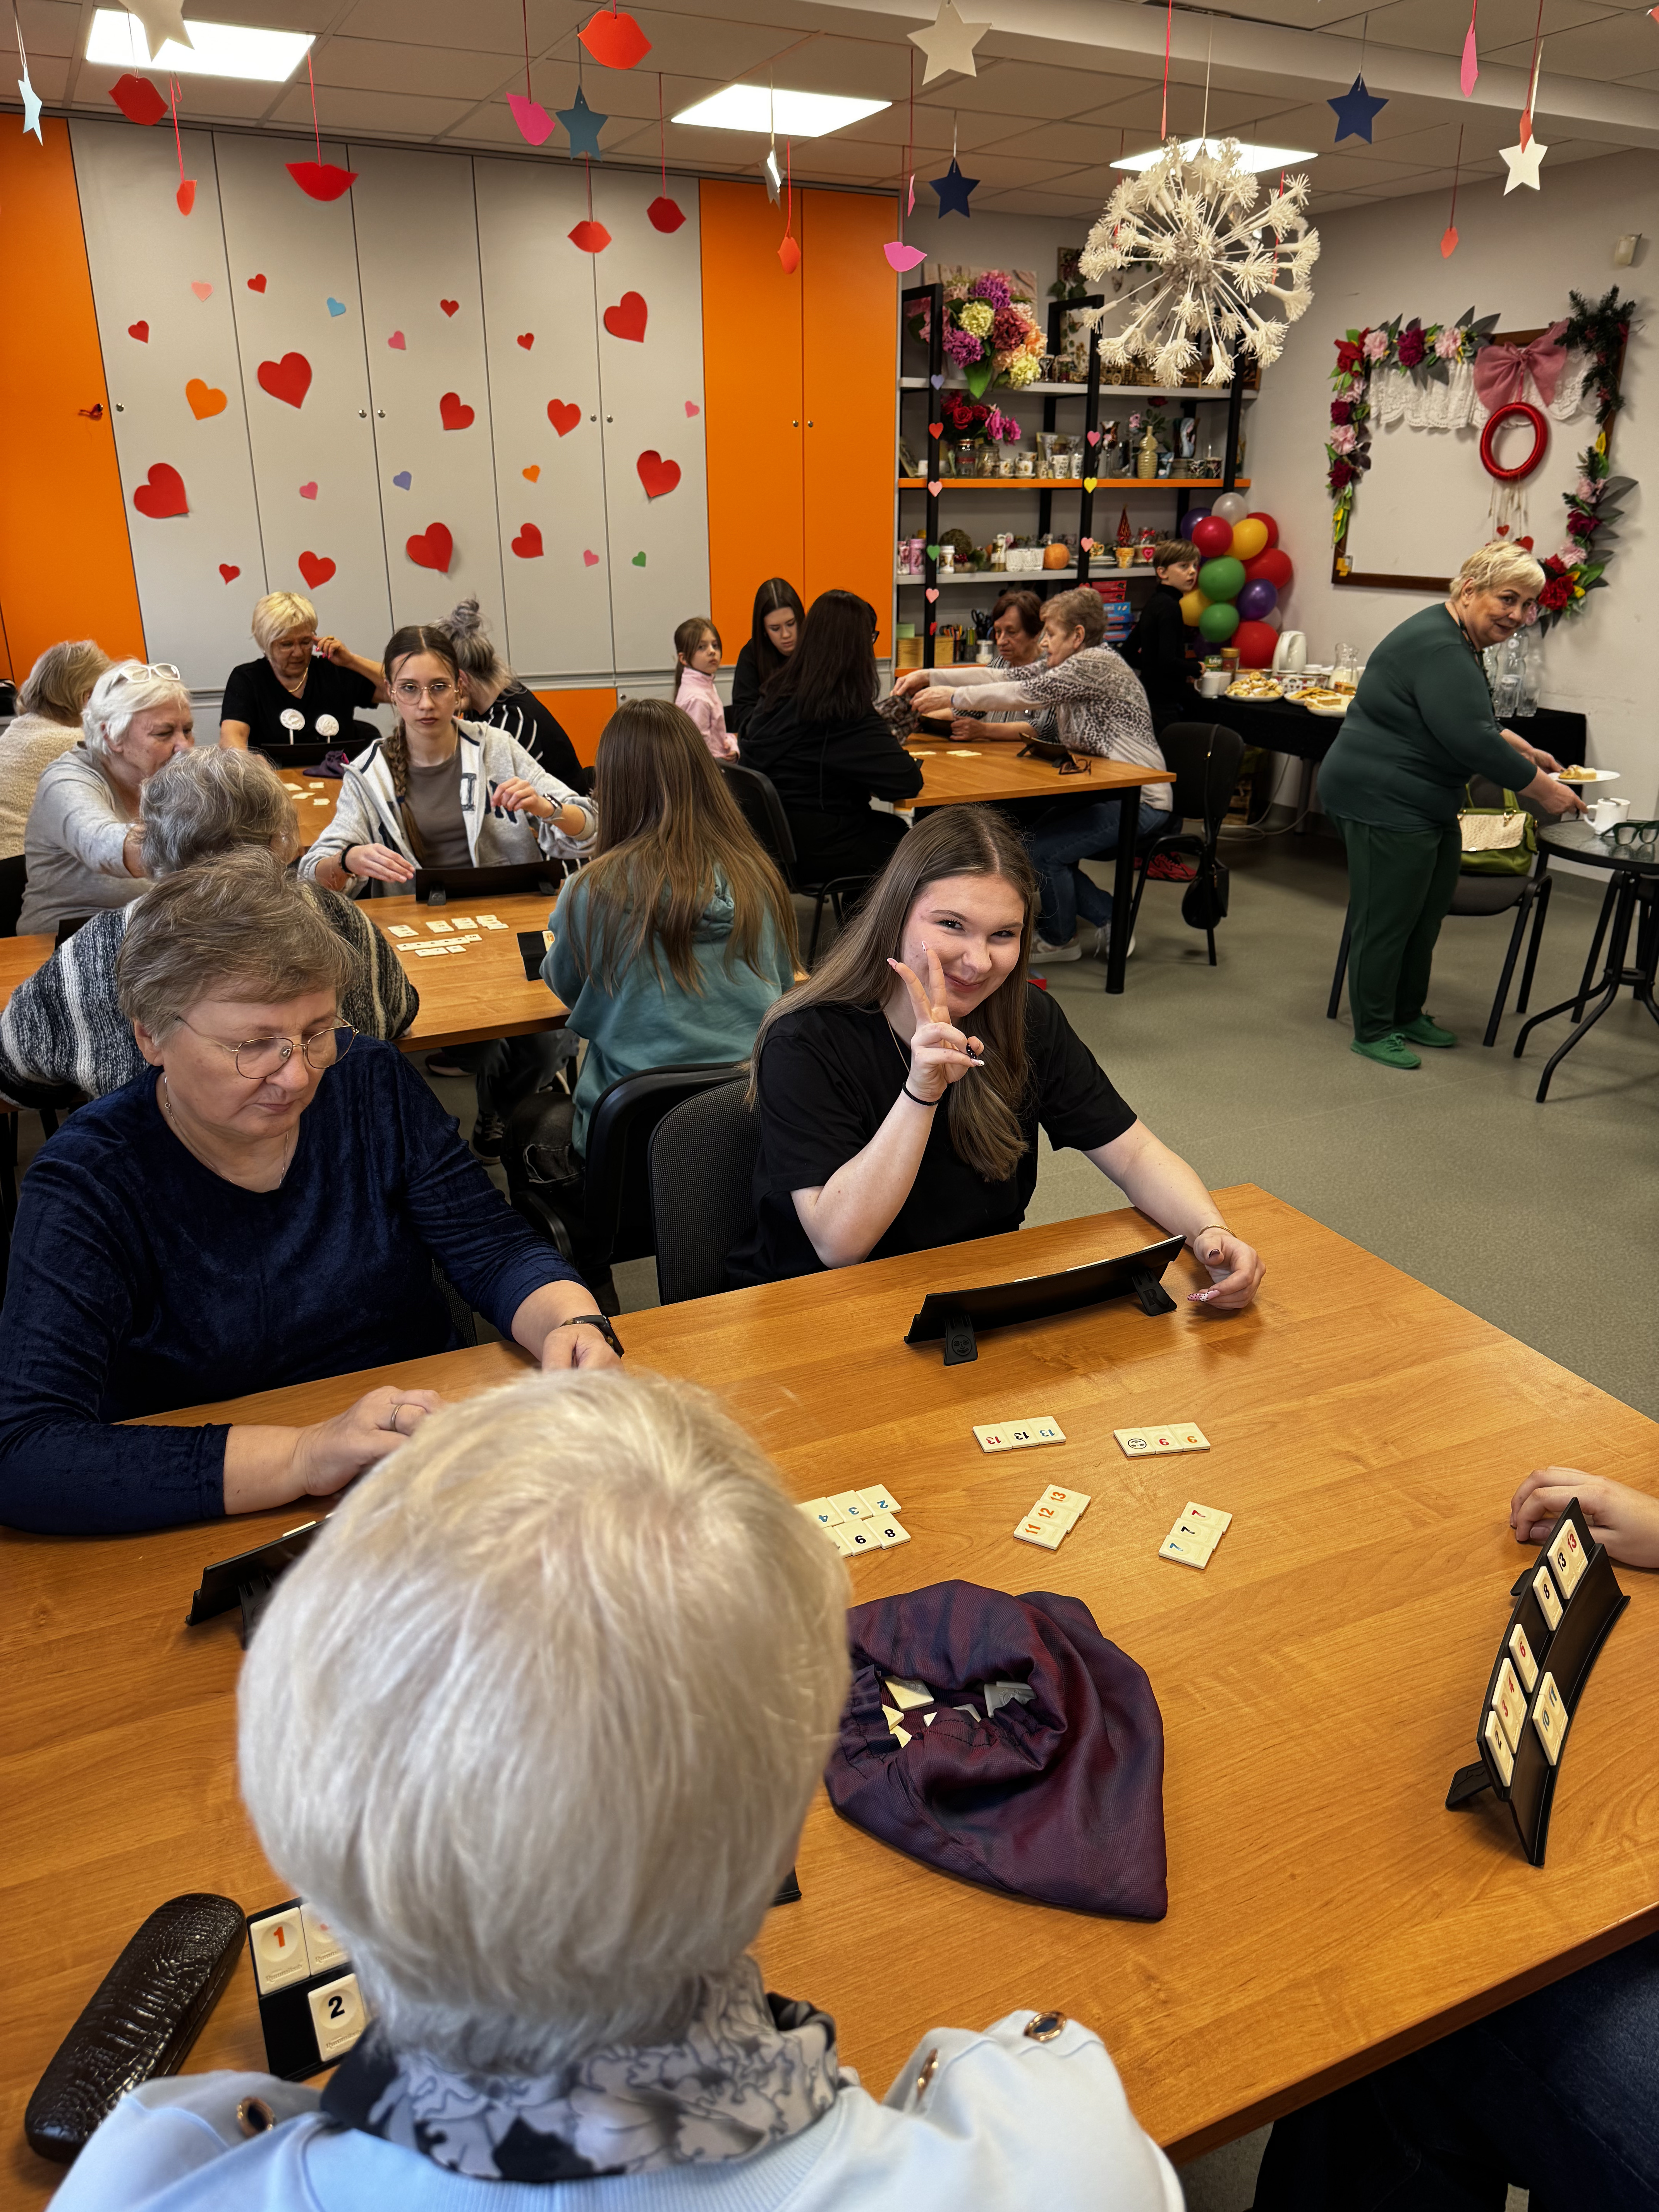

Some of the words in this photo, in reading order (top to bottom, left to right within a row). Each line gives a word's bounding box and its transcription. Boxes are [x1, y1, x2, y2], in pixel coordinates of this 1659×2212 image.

[1014, 1432, 1029, 1440] 13
[877, 1500, 888, 1509] 2
[1050, 1492, 1066, 1502] 13
[1038, 1508, 1054, 1518] 12
[1192, 1510, 1206, 1518] 7
[884, 1529, 896, 1537] 8
[1025, 1524, 1041, 1534] 11
[1181, 1526, 1195, 1534] 7
[1170, 1542, 1183, 1551] 7
[1568, 1534, 1577, 1553] 13
[1558, 1552, 1566, 1572] 13
[1544, 1583, 1550, 1599] 8
[1520, 1641, 1526, 1657] 6
[1508, 1676, 1515, 1693] 4
[1549, 1685, 1557, 1707] 11
[1502, 1700, 1508, 1717] 3
[1542, 1709, 1549, 1732] 10
[1495, 1730, 1501, 1750] 2
[273, 1926, 285, 1948] 1
[266, 1964, 302, 1982] Rummikub
[328, 1995, 345, 2019] 2
